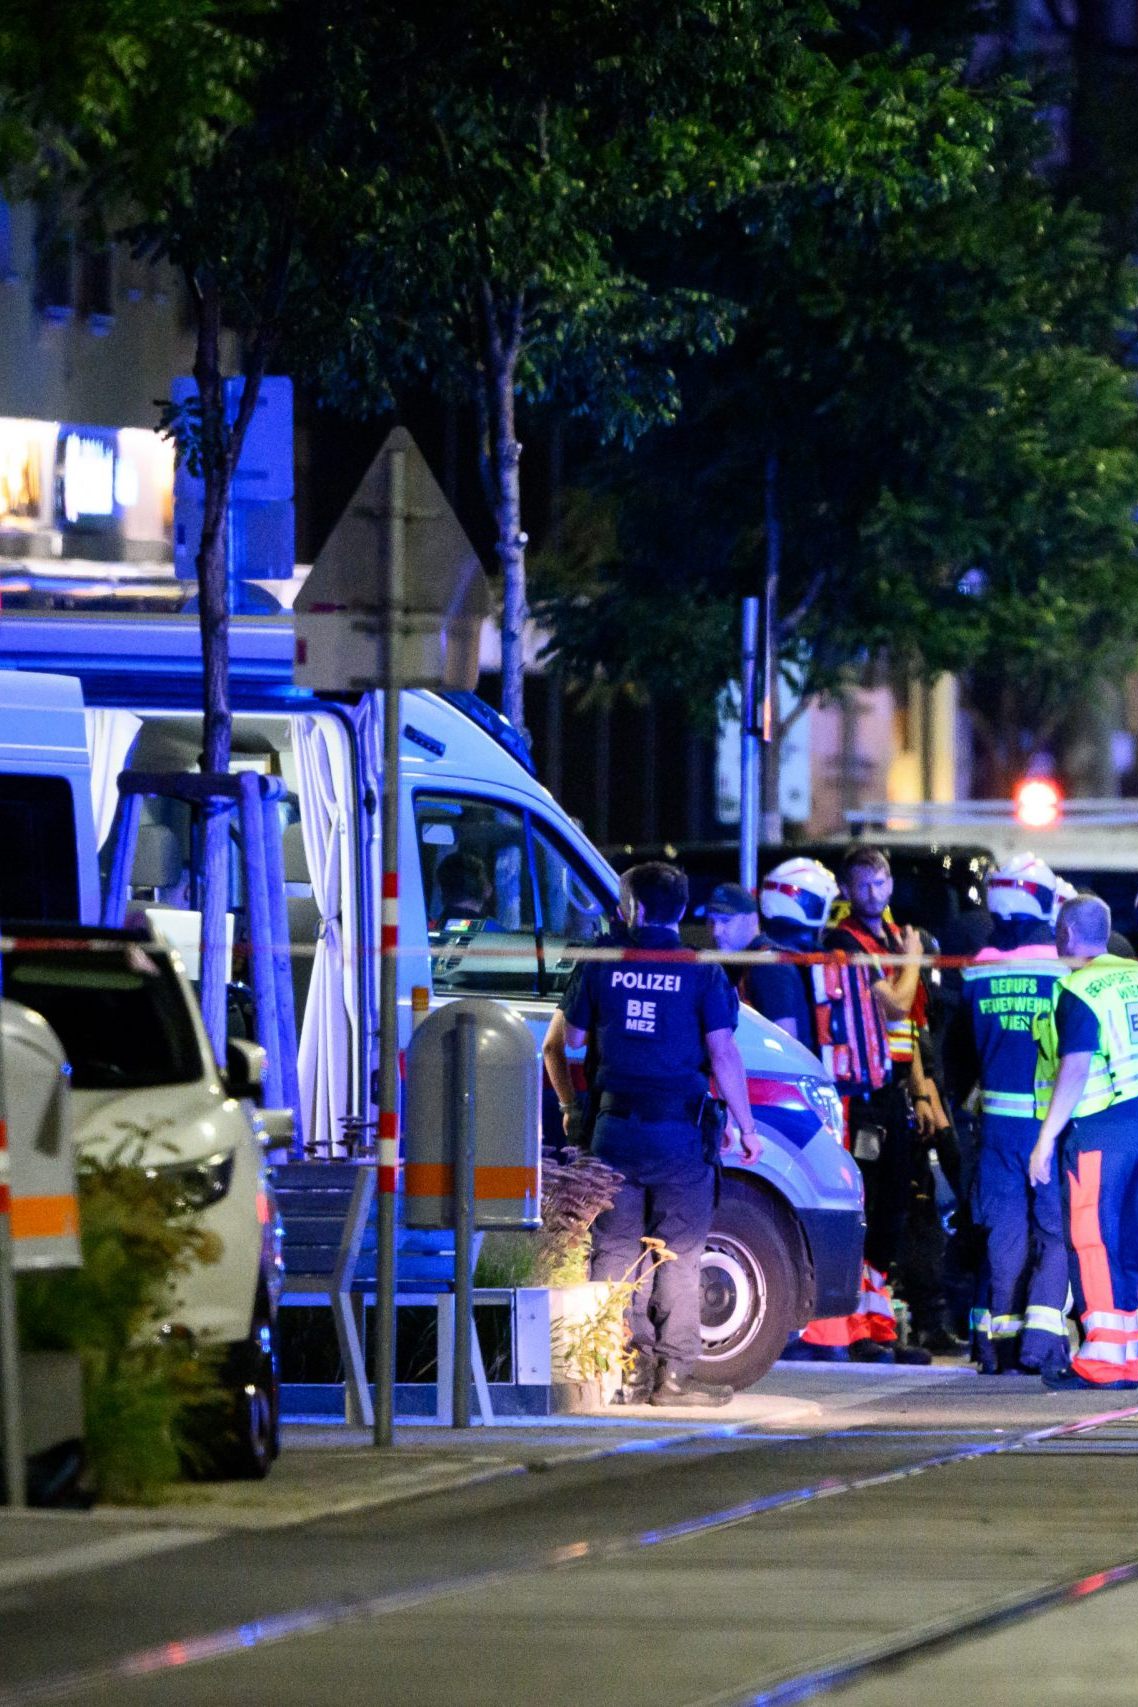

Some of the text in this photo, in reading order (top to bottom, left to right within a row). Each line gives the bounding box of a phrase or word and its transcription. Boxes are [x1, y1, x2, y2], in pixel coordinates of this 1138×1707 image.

[611, 971, 681, 992] POLIZEI
[627, 999, 657, 1019] BE
[626, 1018, 656, 1033] MEZ
